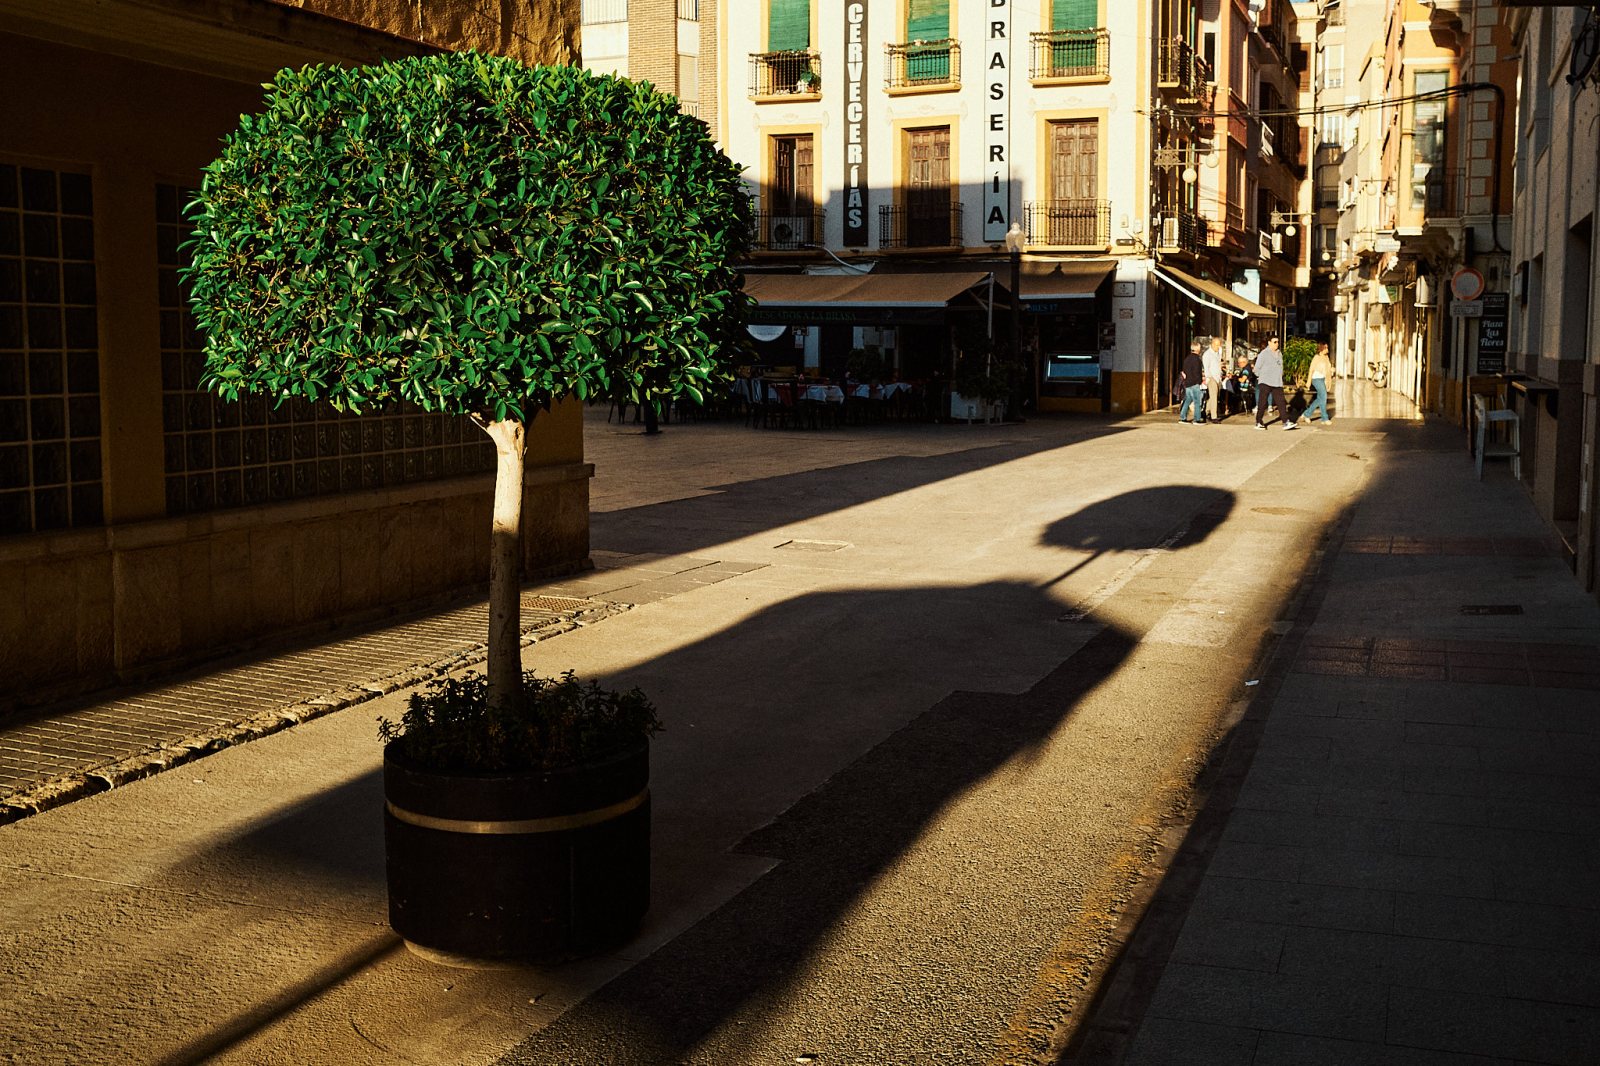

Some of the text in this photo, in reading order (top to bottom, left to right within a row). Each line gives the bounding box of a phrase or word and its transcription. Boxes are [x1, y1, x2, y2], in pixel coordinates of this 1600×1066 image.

[847, 3, 863, 229] CERVECERÍAS
[825, 311, 856, 320] BRASA
[1482, 320, 1503, 328] Plaza
[1486, 328, 1499, 339] Las
[1480, 338, 1504, 347] Flores
